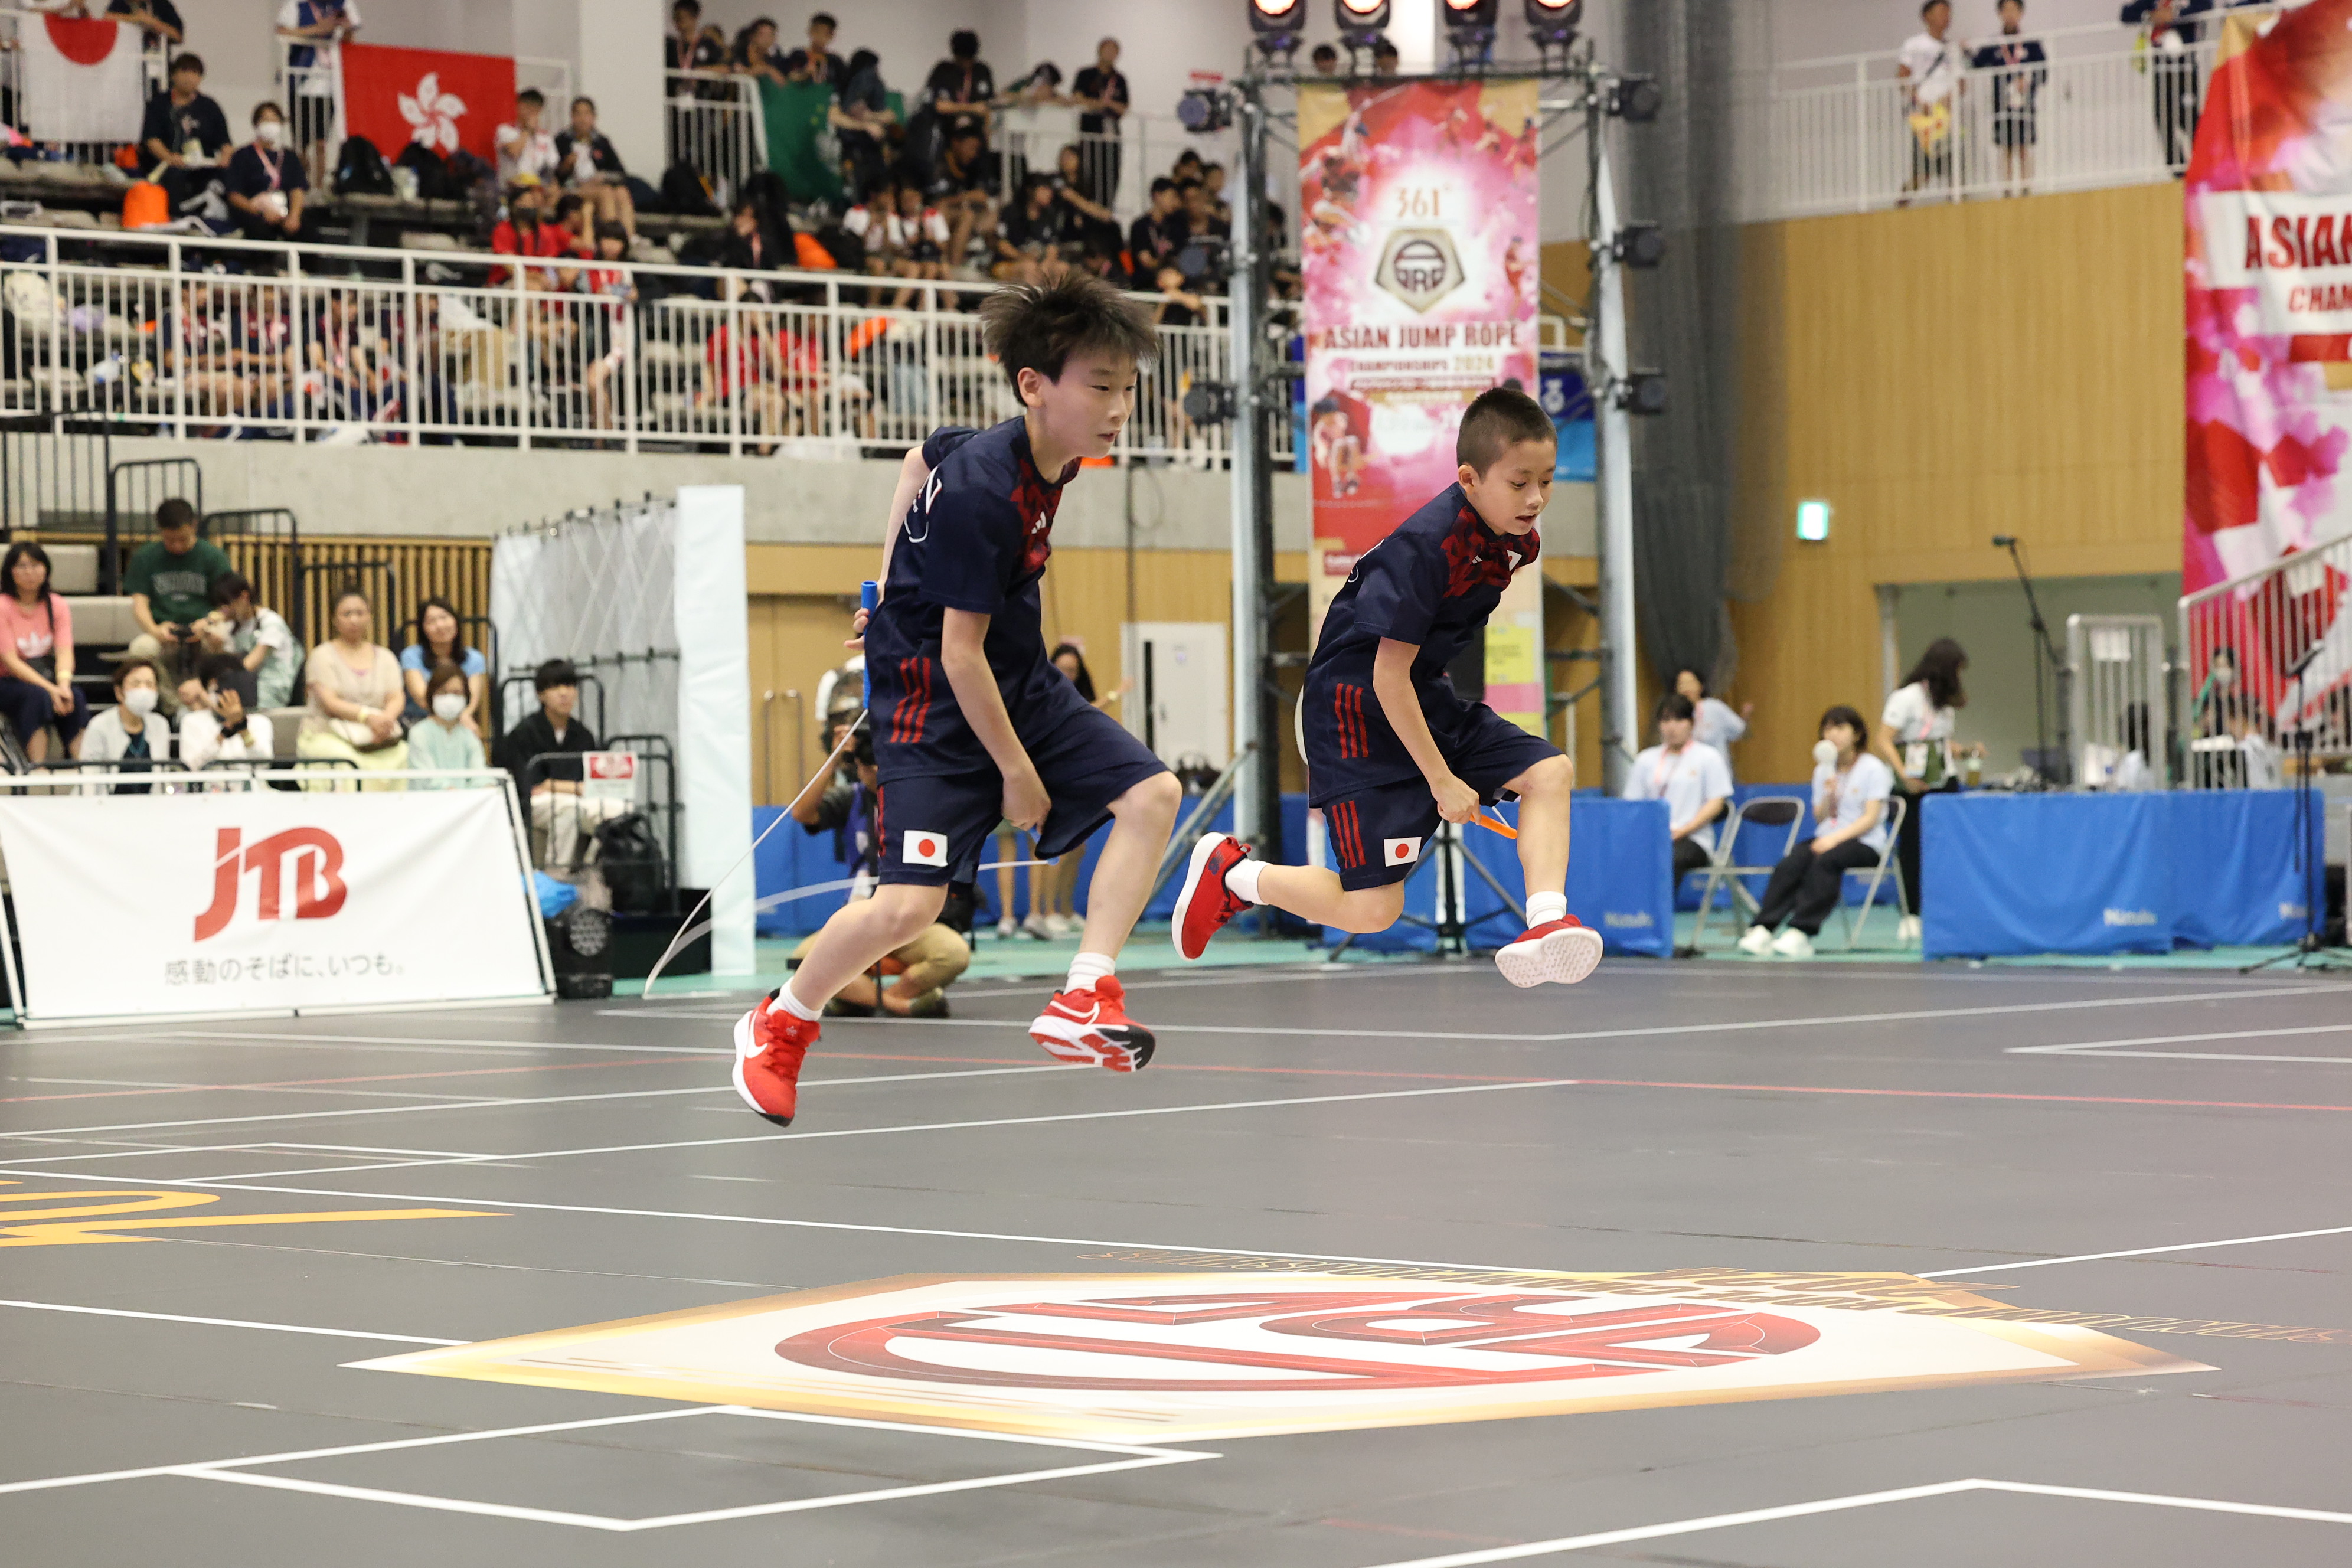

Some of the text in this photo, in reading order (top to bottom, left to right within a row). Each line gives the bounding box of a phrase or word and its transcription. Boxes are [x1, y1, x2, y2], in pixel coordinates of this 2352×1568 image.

[1325, 323, 1517, 348] ASIAN JUMP ROPE
[194, 827, 347, 942] JTB
[165, 952, 406, 986] 感動のそばに、いつも。
[1076, 1250, 2352, 1345] SIAN JUMP ROPE CHAMPIONSHIPS
[1612, 1266, 2021, 1298] 2024
